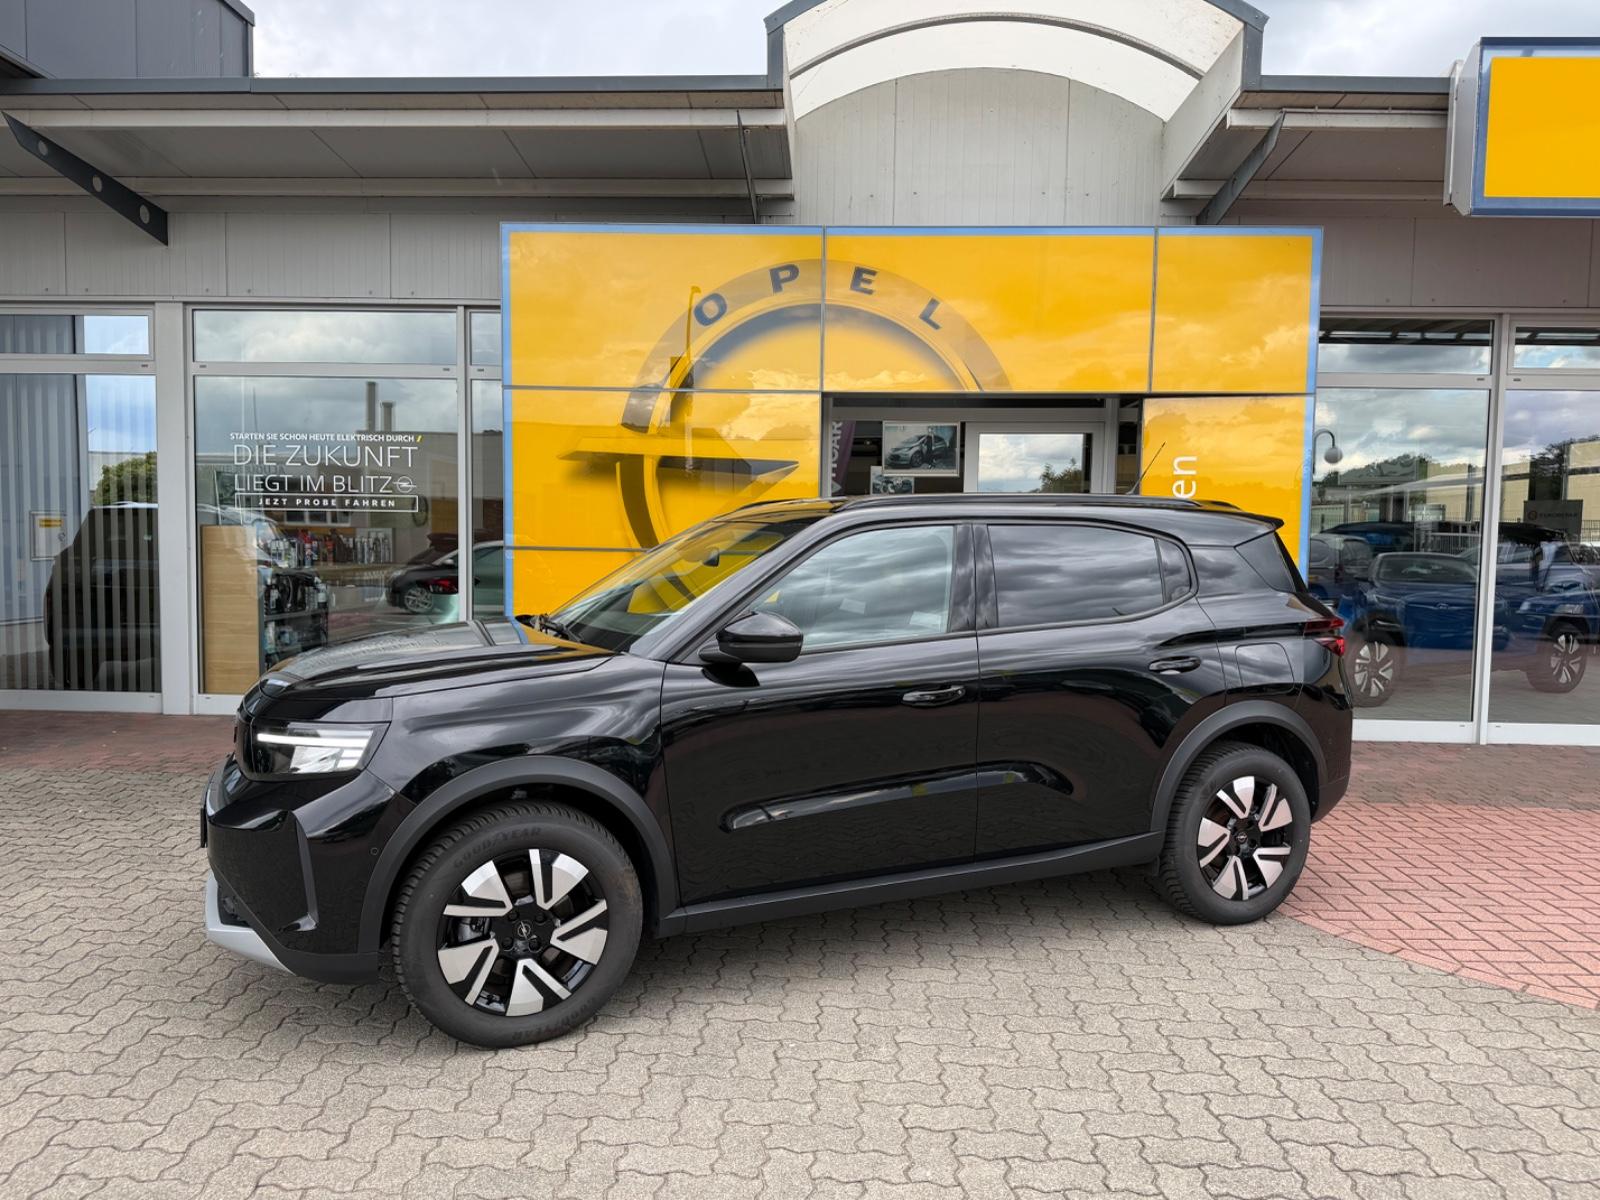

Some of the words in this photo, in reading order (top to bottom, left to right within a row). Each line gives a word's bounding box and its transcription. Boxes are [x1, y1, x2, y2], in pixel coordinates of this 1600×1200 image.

[694, 263, 945, 331] OPEL
[230, 433, 264, 441] STARTEN
[266, 433, 278, 441] SIE
[309, 433, 335, 441] HEUTE
[336, 434, 385, 442] ELEKTRISCH
[386, 435, 415, 443] DURCH
[234, 445, 277, 466] DIE
[285, 446, 418, 467] ZUKUNFT
[235, 474, 293, 492] LIEGT
[300, 475, 325, 492] IM
[333, 475, 393, 493] BLITZ
[296, 498, 337, 506] PROBE
[345, 498, 396, 507] FAHREN
